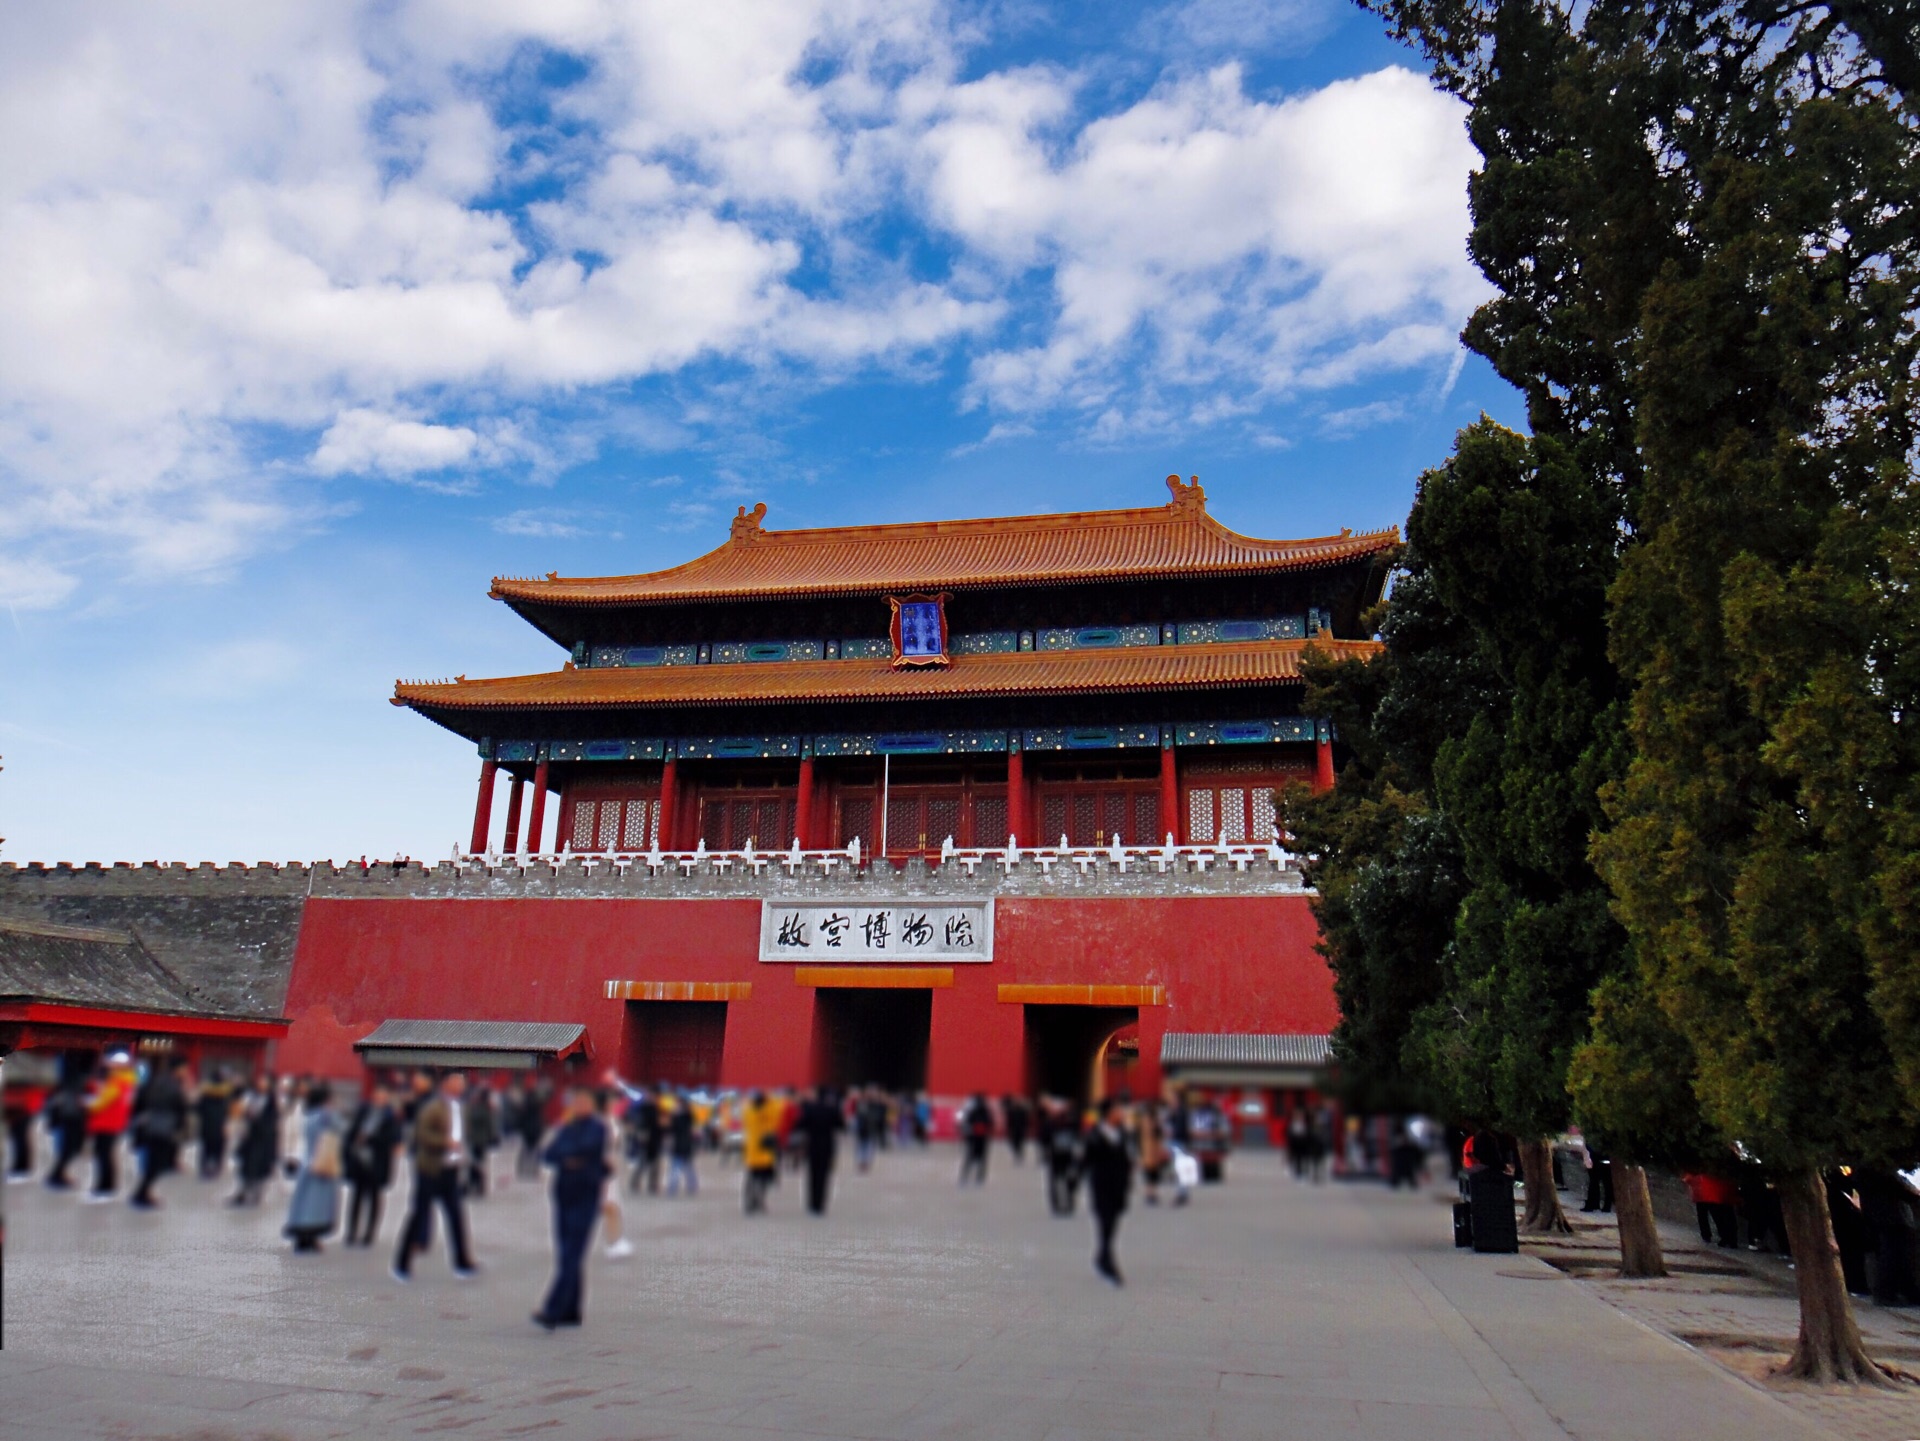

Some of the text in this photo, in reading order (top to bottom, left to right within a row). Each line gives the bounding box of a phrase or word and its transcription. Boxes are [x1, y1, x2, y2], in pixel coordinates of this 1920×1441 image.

[777, 911, 975, 949] 故宫博物院
